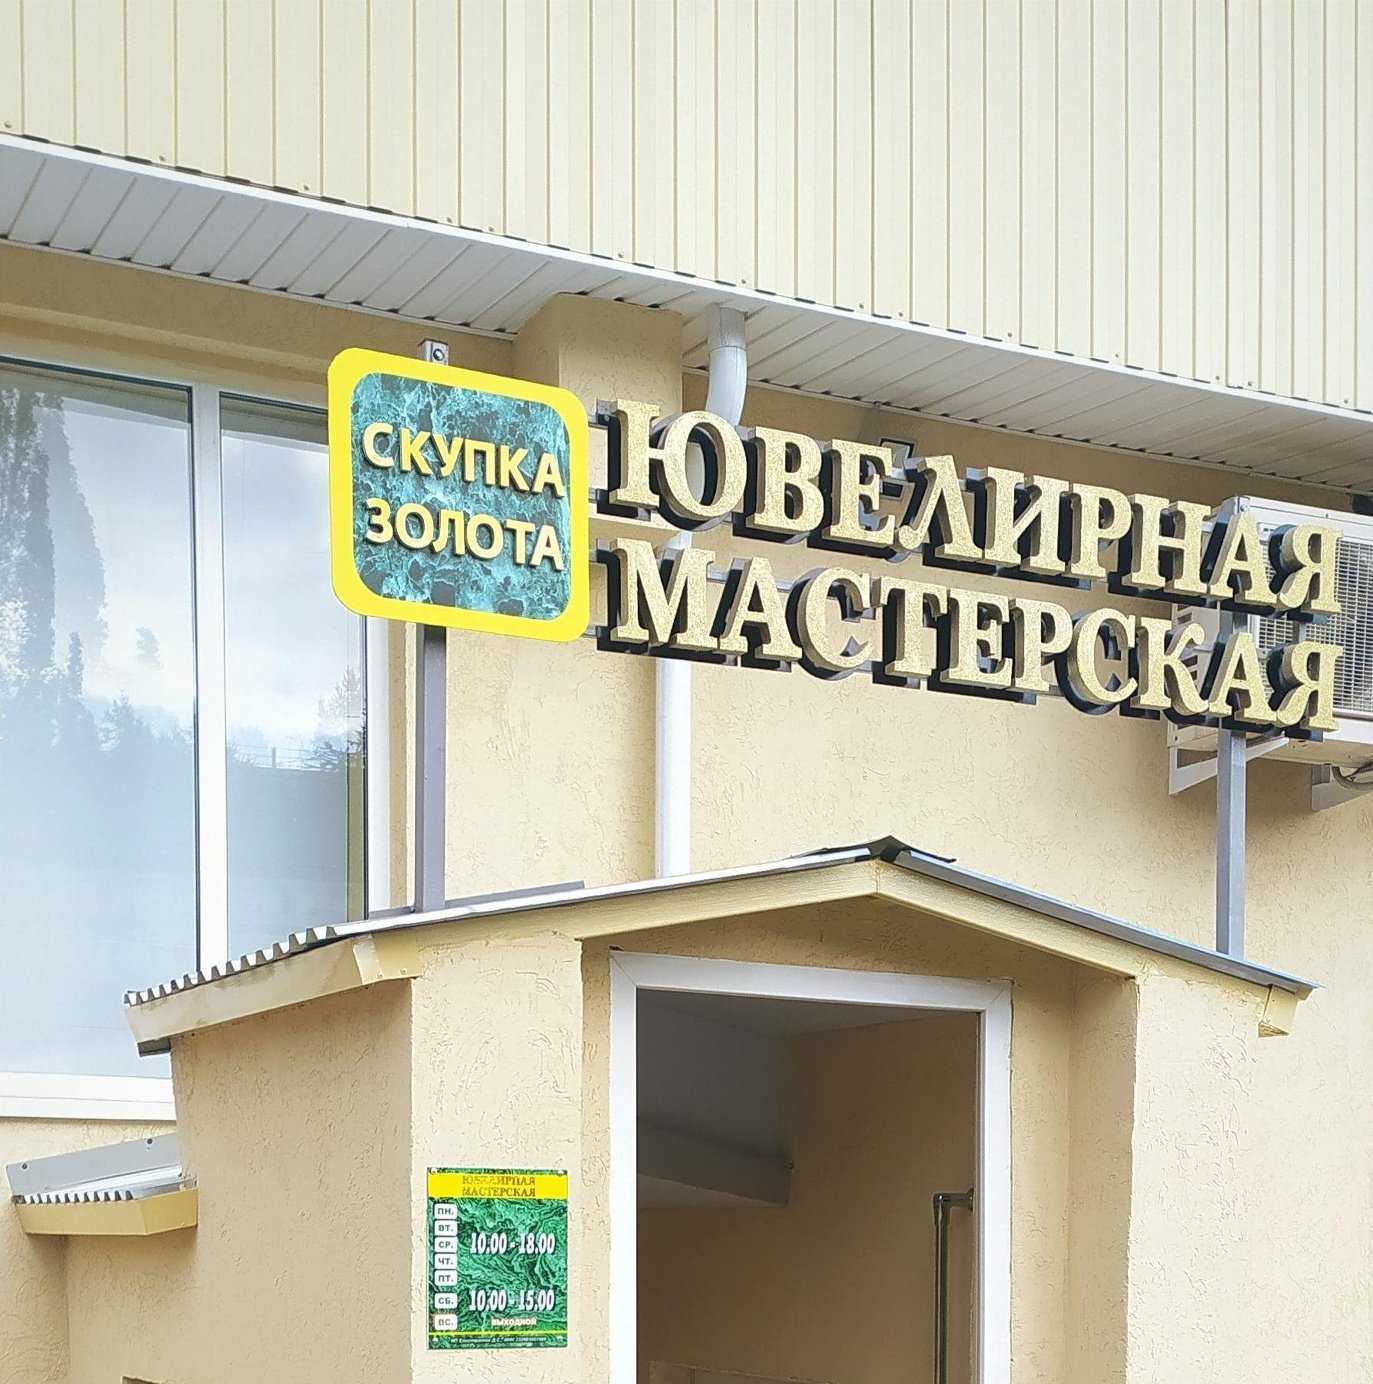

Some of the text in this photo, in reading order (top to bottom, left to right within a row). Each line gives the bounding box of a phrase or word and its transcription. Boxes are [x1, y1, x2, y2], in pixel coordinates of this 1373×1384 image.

[362, 422, 565, 498] СКУПКА
[608, 399, 1344, 614] ЮВЕЛИРНАЯ
[365, 498, 565, 571] ЗОЛОТА
[609, 539, 1344, 732] МАСТЕРСКАЯ
[462, 1187, 536, 1198] МАСТЕРСКАЯ
[437, 1207, 454, 1215] ПН.
[438, 1224, 454, 1232] ВТ.
[438, 1241, 454, 1249] СР.
[470, 1232, 508, 1254] 10.00
[519, 1232, 556, 1254] 18.00
[438, 1257, 454, 1265] ЧТ.
[438, 1274, 454, 1282] ПТ.
[438, 1296, 454, 1304] СБ.
[469, 1289, 507, 1311] 10.00
[519, 1289, 555, 1311] 15.00
